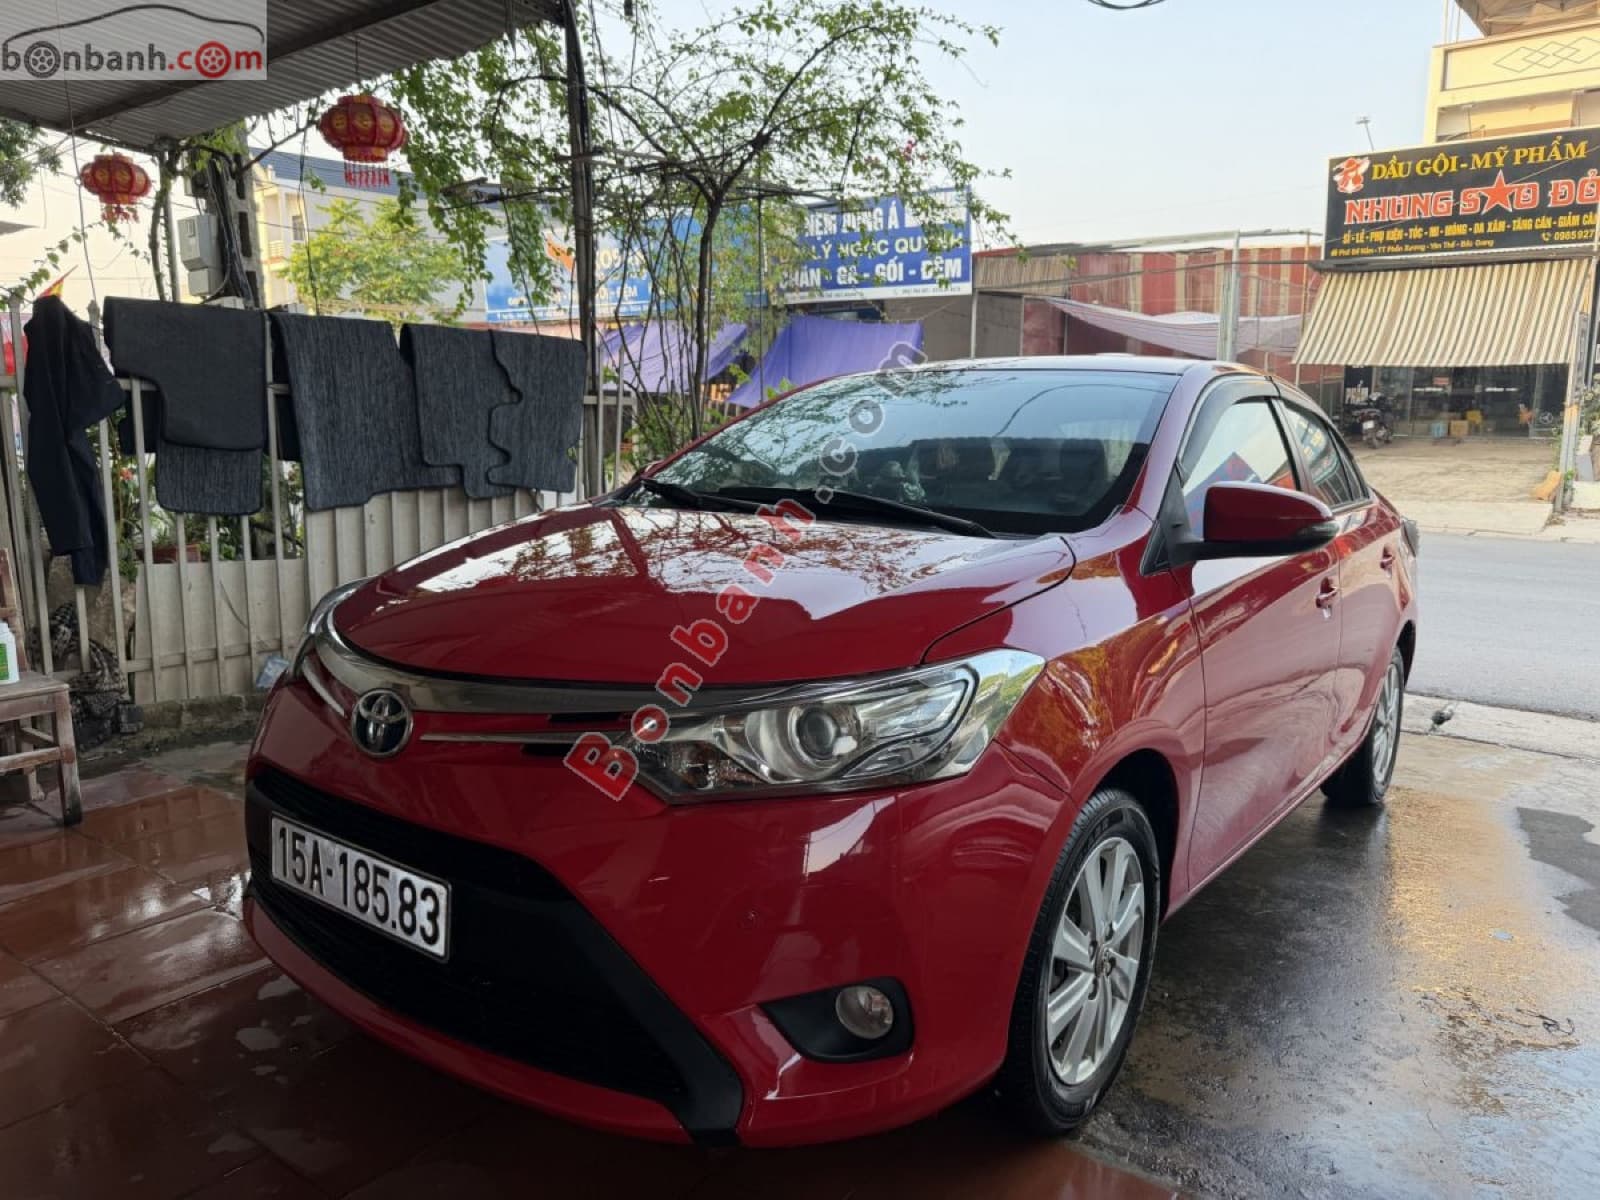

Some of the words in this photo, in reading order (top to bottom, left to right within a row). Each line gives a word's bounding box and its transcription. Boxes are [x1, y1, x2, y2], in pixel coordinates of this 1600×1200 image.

[1371, 155, 1412, 181] DẦU
[1416, 152, 1458, 177] GỘI
[1470, 145, 1509, 170] MỸ
[1514, 135, 1588, 165] PHẨM
[1344, 190, 1454, 225] NHUNG
[278, 826, 440, 946] 15A-185.83
